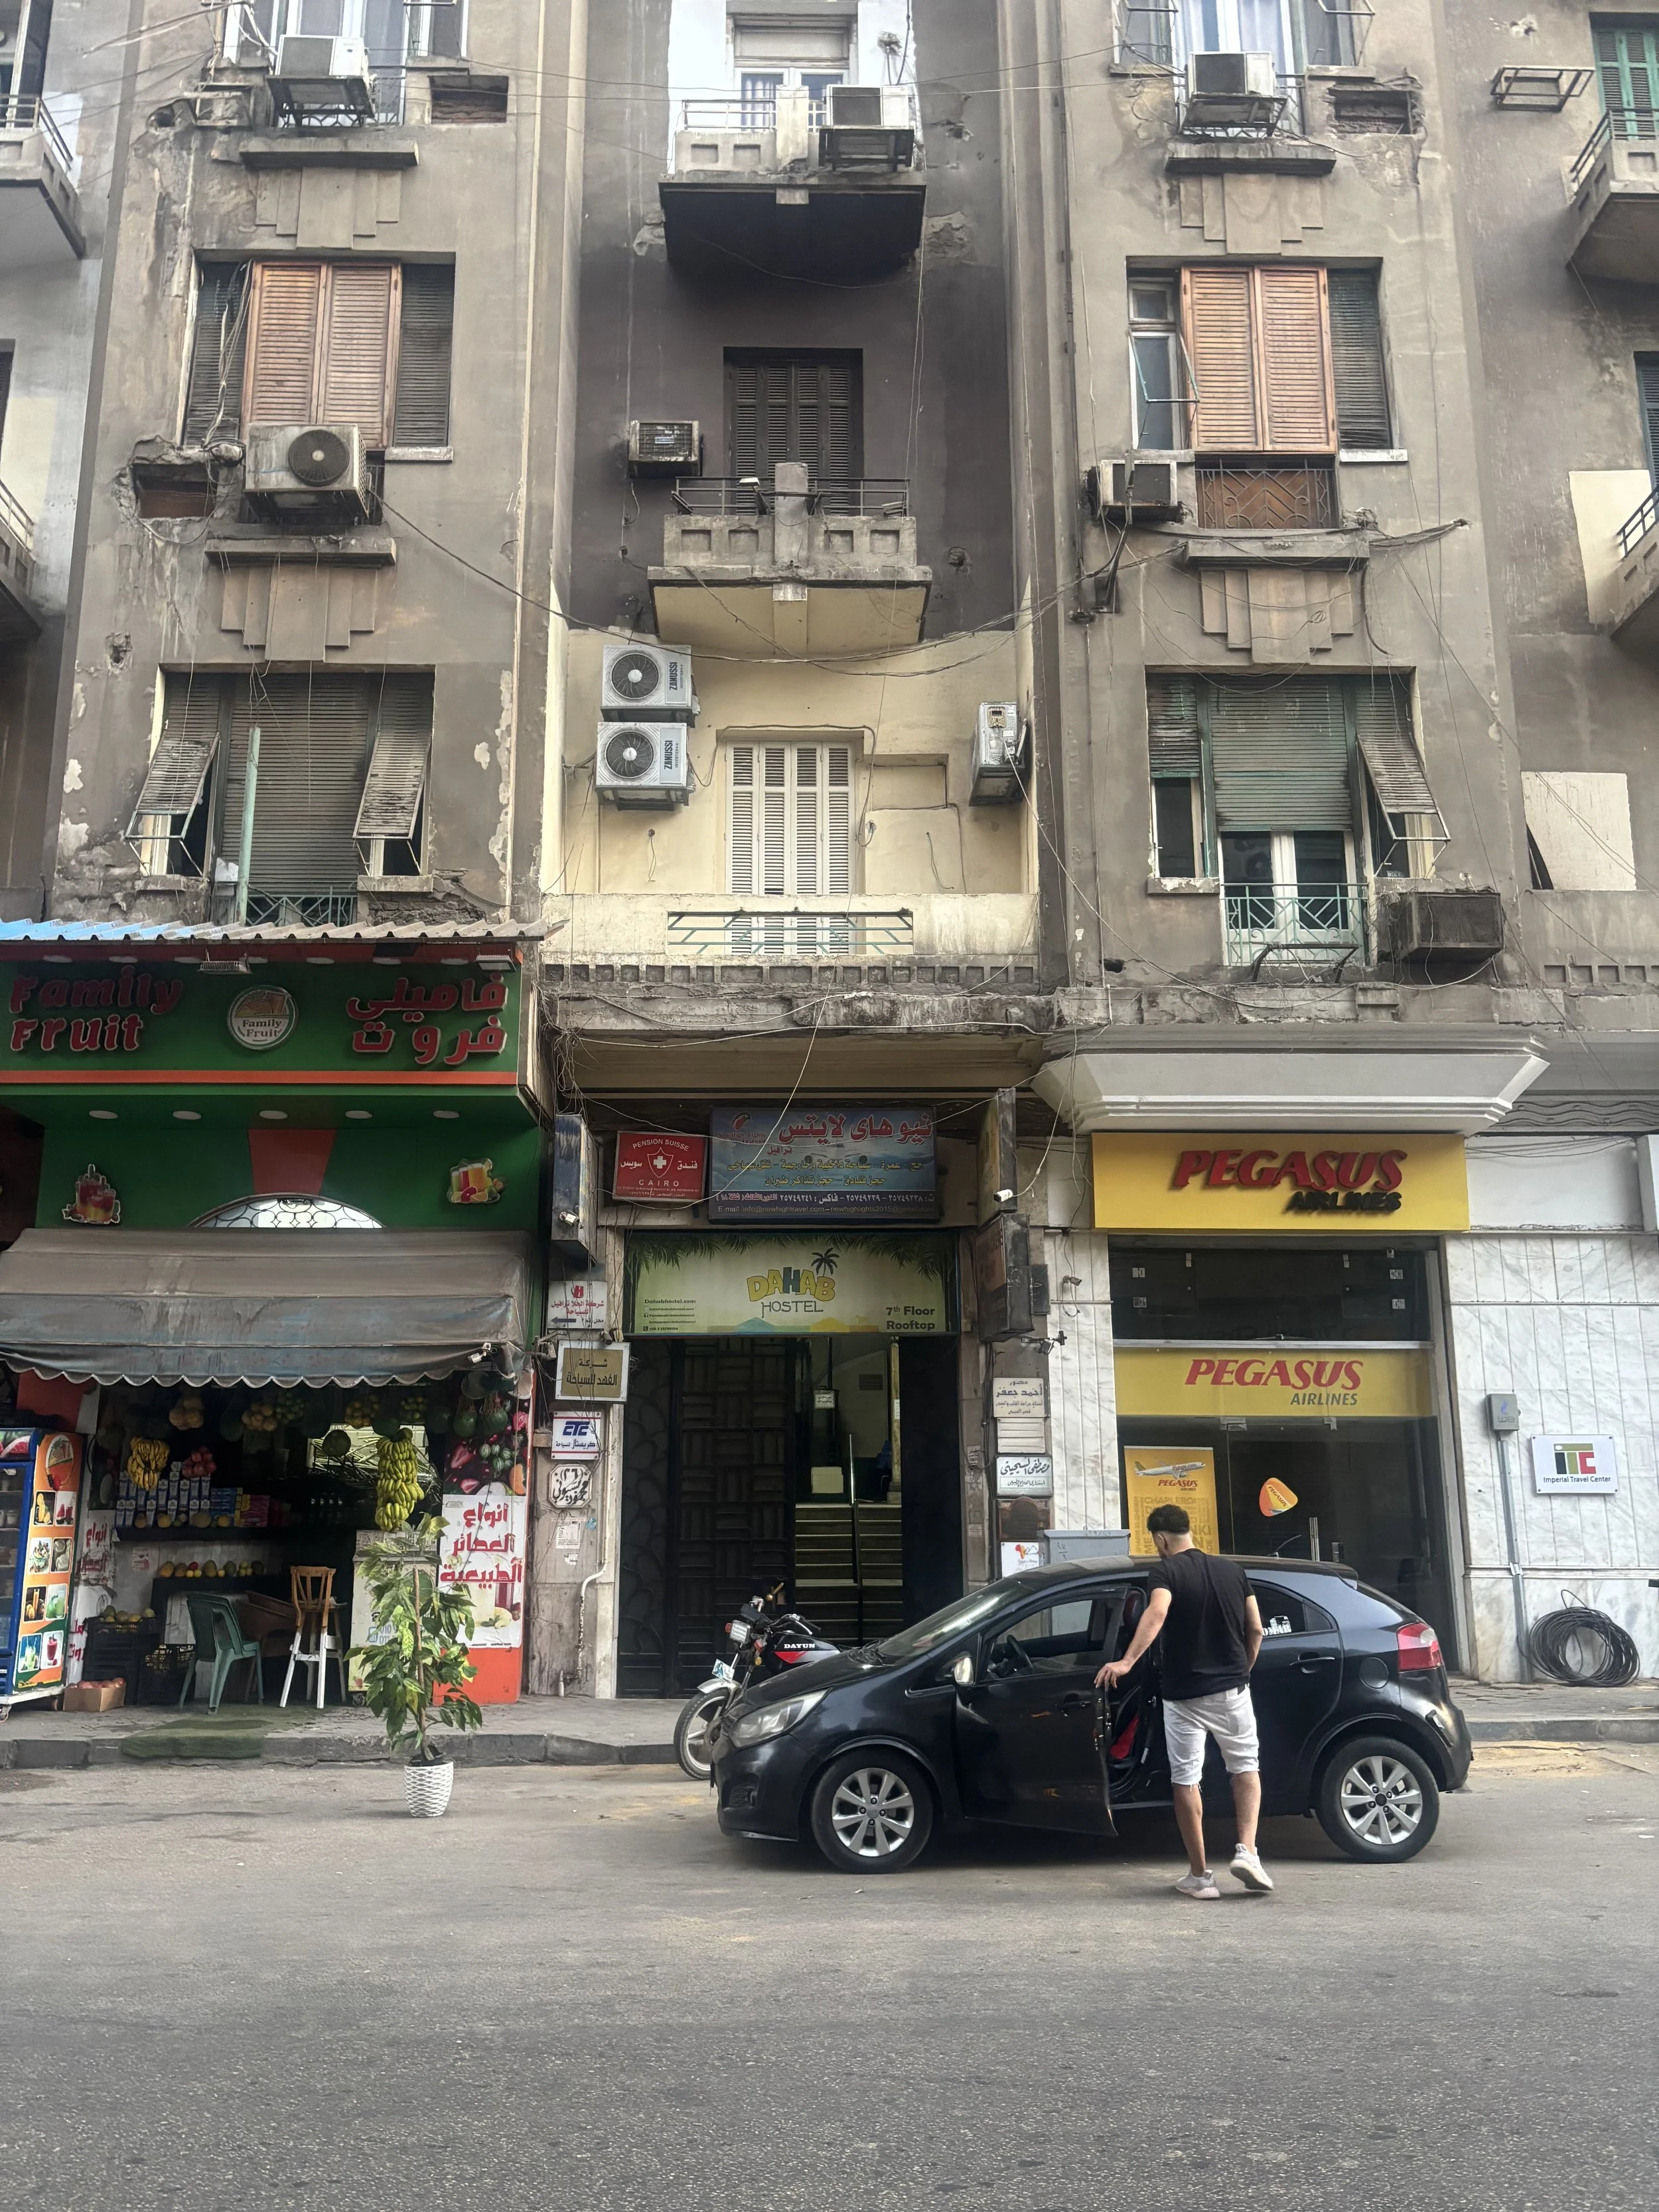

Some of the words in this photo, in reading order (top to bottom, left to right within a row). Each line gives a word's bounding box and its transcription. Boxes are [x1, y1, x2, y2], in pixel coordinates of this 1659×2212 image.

[669, 662, 678, 691] ZANUSSI
[664, 740, 673, 770] ZANUSSI
[9, 964, 182, 1014] Family
[10, 1013, 144, 1052] Fruit
[243, 1019, 282, 1028] Family
[895, 1112, 933, 1144] نيو
[632, 1138, 663, 1149] PENSION
[665, 1139, 689, 1151] SUISSE
[620, 1161, 642, 1169] سويس
[677, 1161, 698, 1170] فندق
[1173, 1148, 1408, 1192] PEGASUS
[1289, 1191, 1402, 1212] AIRLINES
[747, 1266, 835, 1302] DAHAB
[761, 1300, 824, 1319] HOSTEL
[886, 1305, 901, 1315] 7th
[904, 1305, 935, 1315] Floor
[886, 1320, 935, 1331] Rooftop
[579, 1359, 608, 1368] شركة
[567, 1371, 596, 1388] للسياحة
[1185, 1359, 1364, 1391] PEGASUS
[1290, 1392, 1358, 1407] AIRLINES
[1267, 1485, 1287, 1507] PEGASUS
